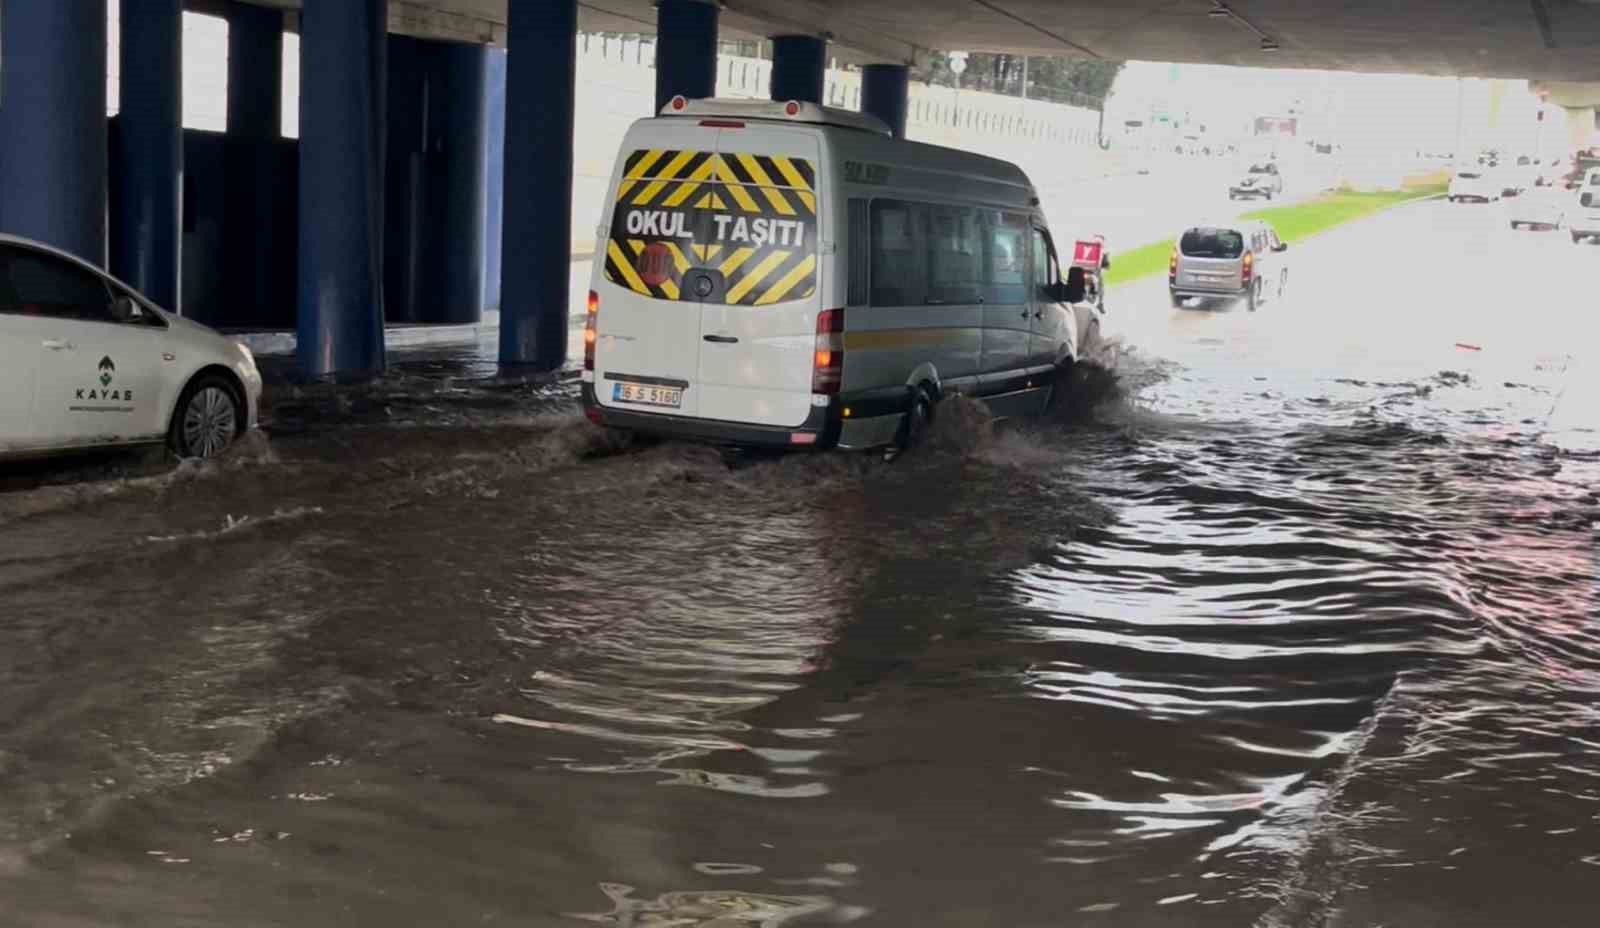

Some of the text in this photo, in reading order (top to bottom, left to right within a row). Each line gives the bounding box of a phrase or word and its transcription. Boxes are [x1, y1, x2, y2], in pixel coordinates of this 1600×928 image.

[626, 210, 804, 249] OKUL TAŞITI
[637, 388, 645, 400] S
